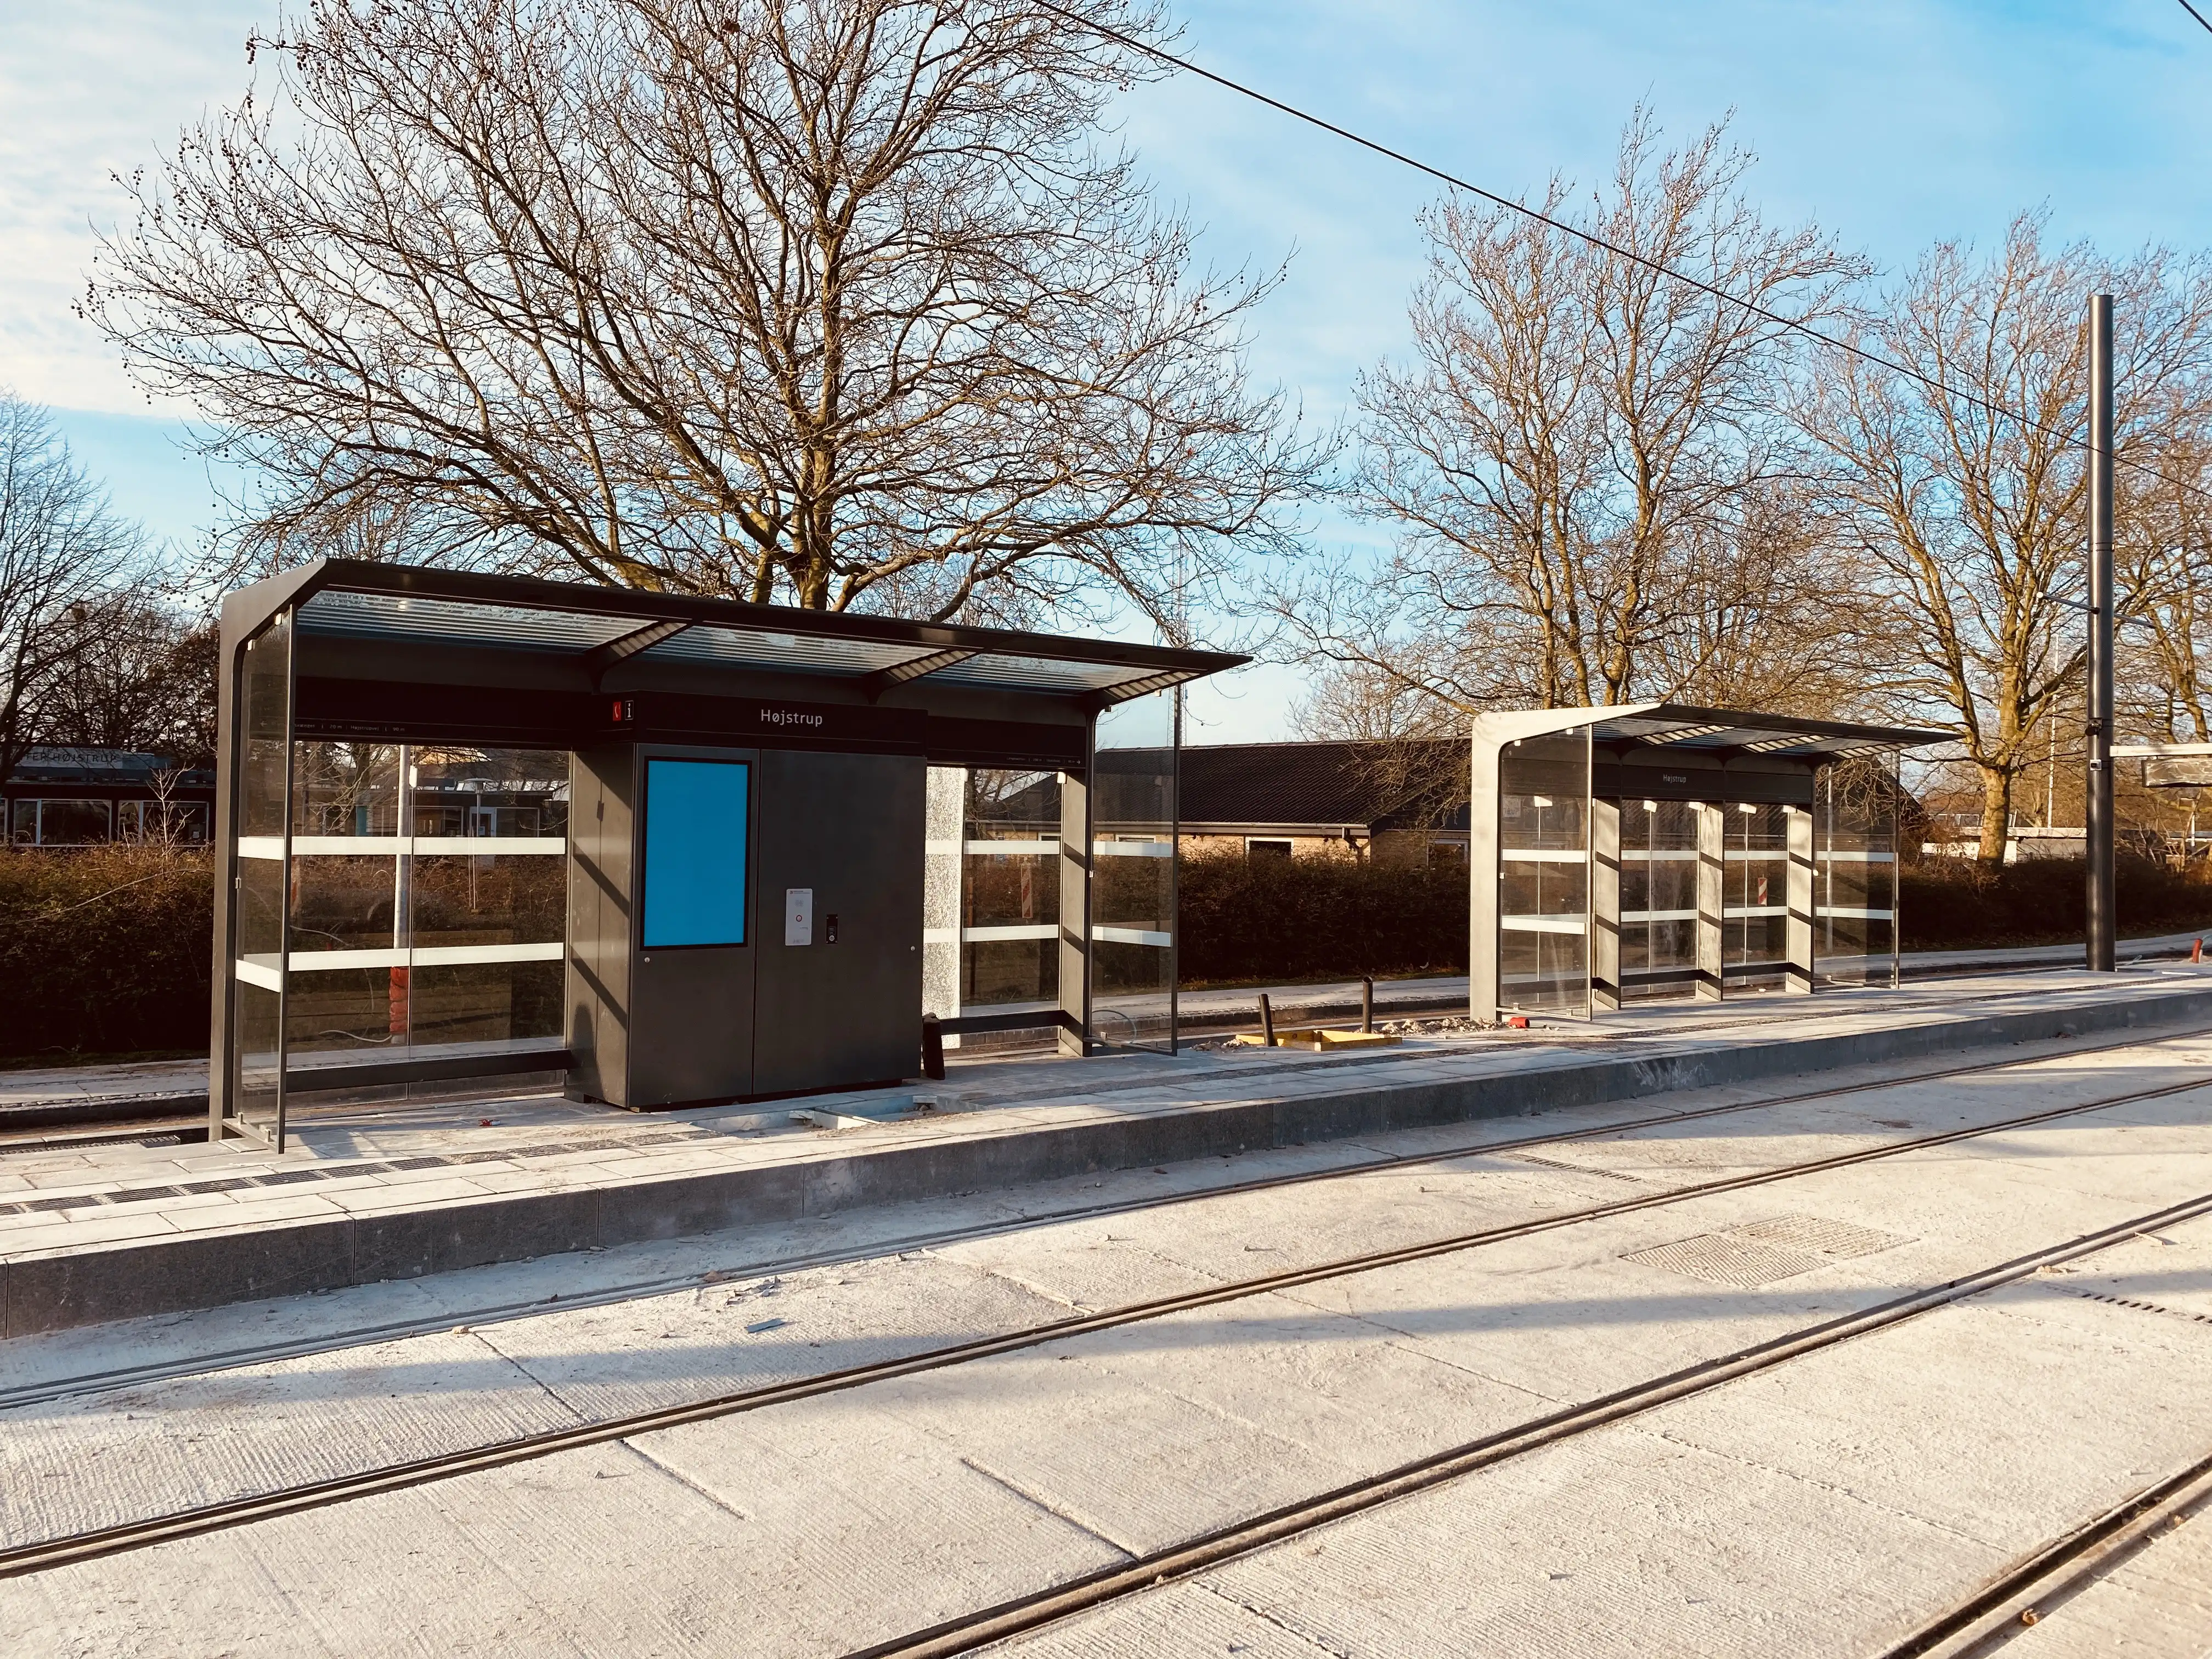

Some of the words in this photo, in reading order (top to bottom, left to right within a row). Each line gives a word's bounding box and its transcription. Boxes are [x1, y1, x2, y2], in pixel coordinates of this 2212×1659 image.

[761, 709, 822, 727] Højstrup
[25, 752, 48, 761] TER
[53, 753, 116, 763] HØJSTRUP
[1663, 774, 1686, 783] Højstrup
